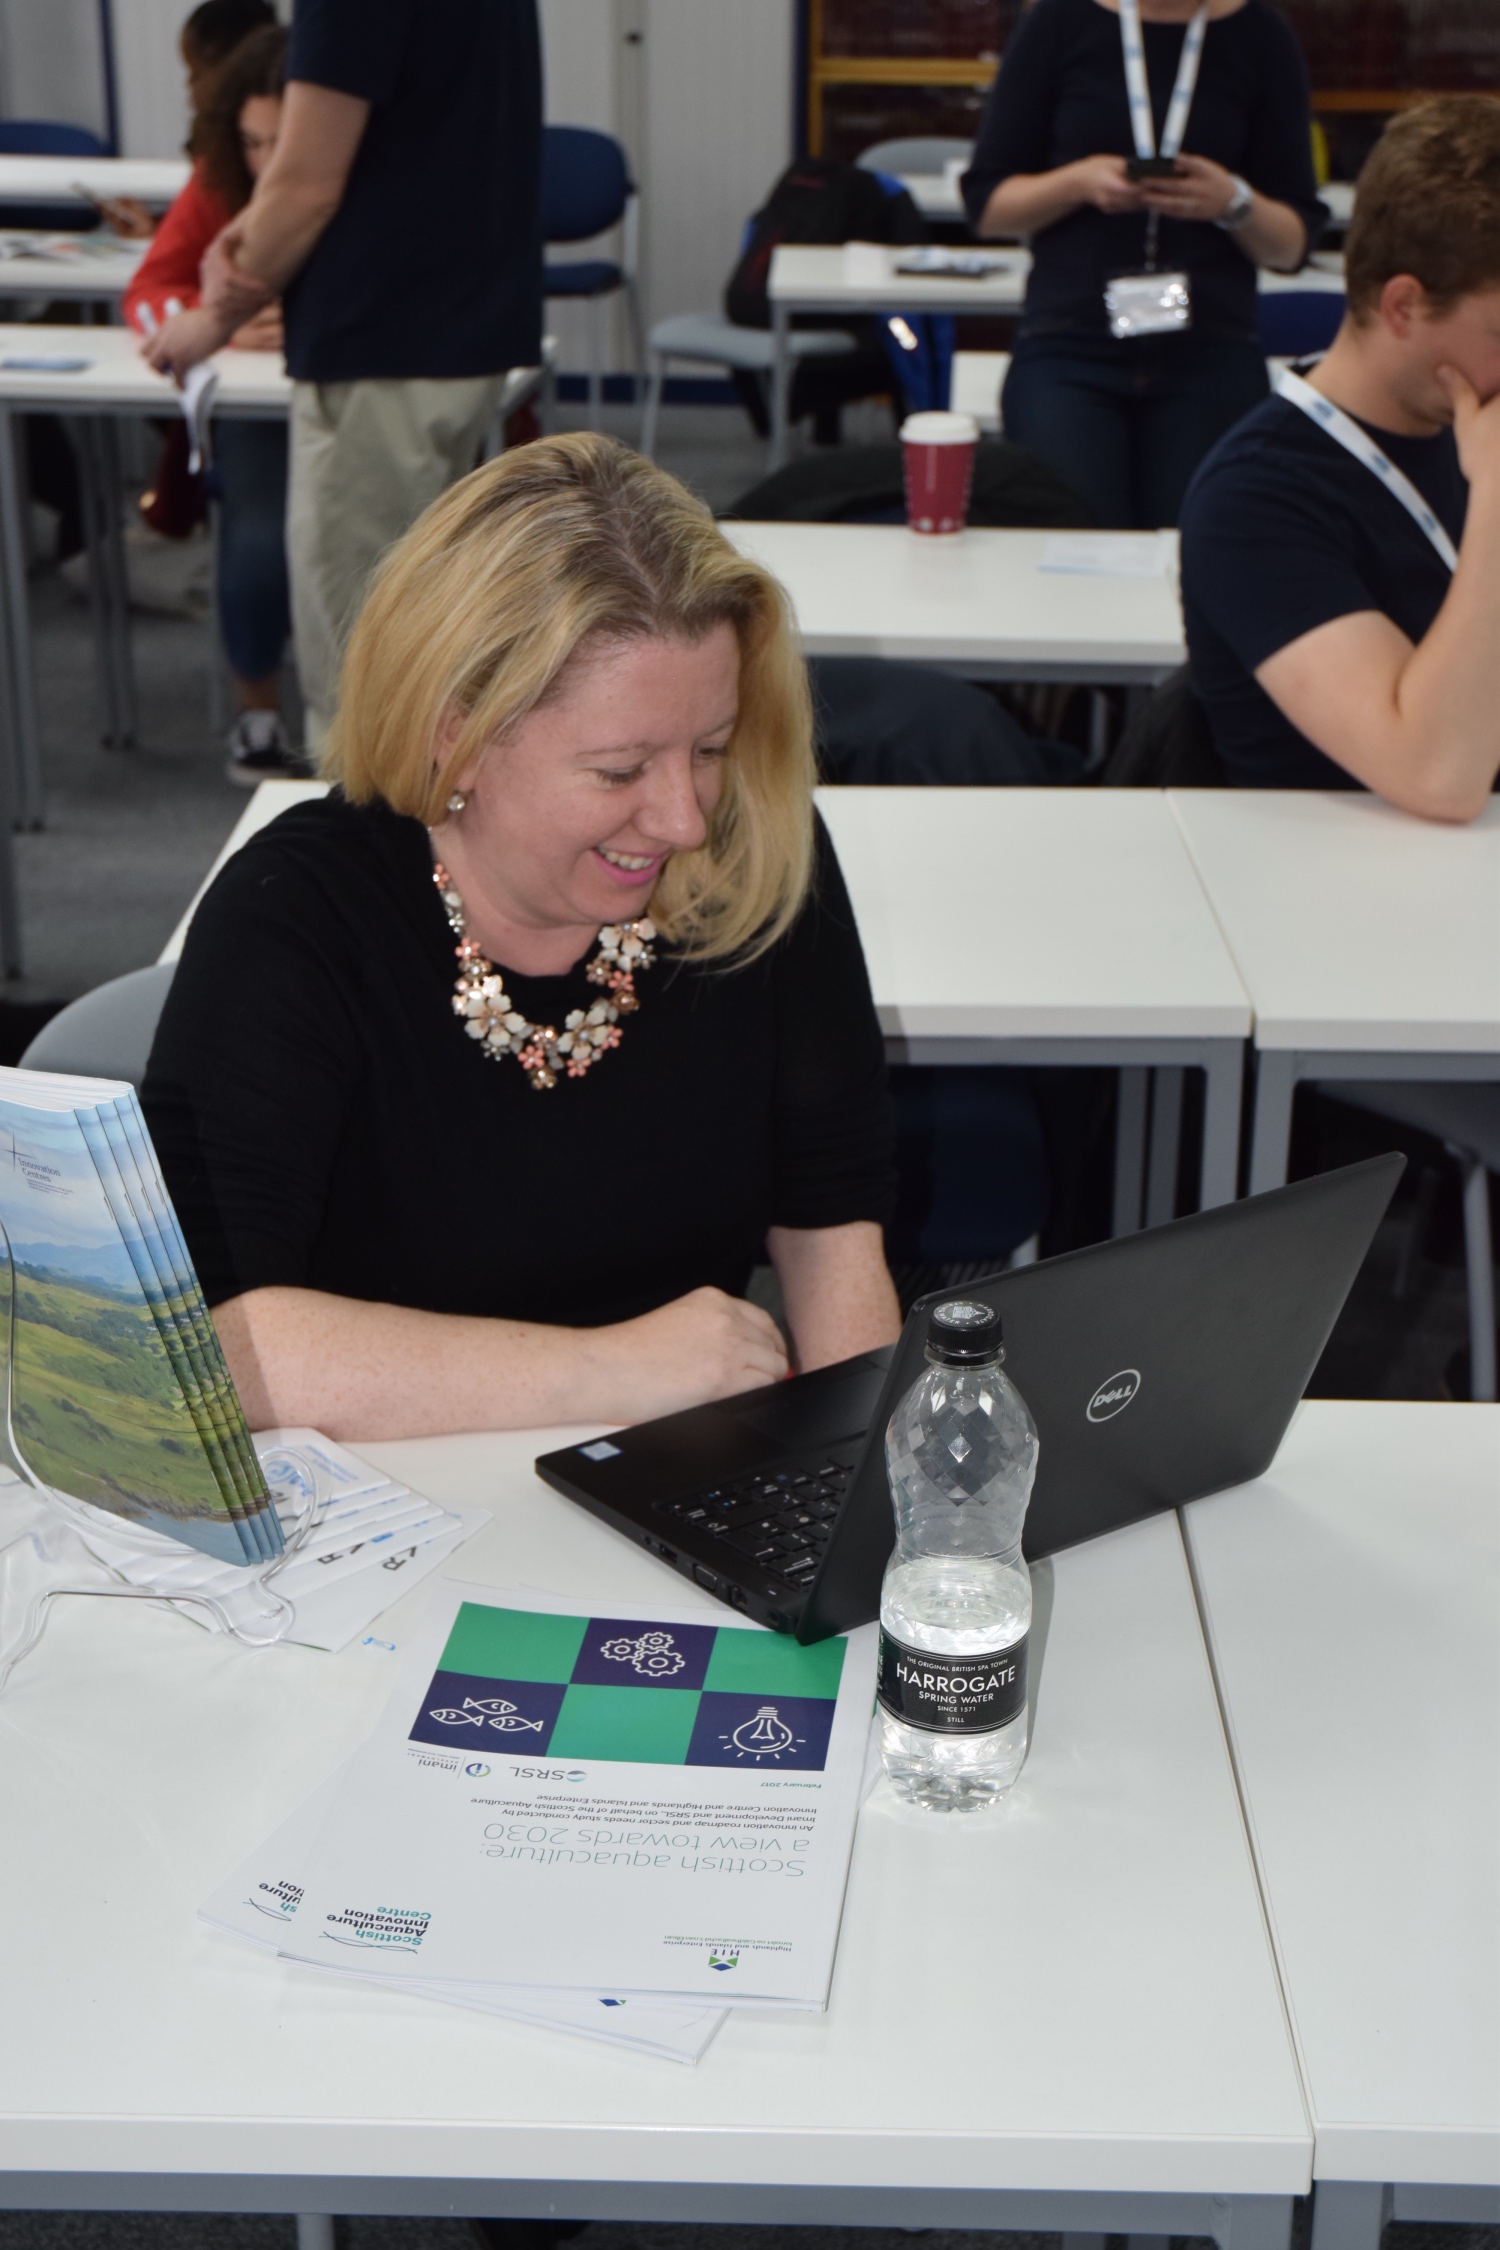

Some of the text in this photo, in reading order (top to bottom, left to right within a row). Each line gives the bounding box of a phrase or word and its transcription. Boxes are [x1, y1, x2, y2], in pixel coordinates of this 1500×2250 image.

[18, 1158, 61, 1176] Innovation
[22, 1168, 52, 1182] Centres
[1092, 1384, 1132, 1408] DELL
[906, 1656, 916, 1665] THE
[918, 1660, 950, 1672] ORIGINAL
[990, 1658, 1008, 1668] TOWN
[896, 1662, 1016, 1693] HARROGATE
[918, 1690, 994, 1704] SPRING WATER
[418, 1759, 457, 1772] imani
[509, 1766, 566, 1781] SRSL
[470, 1798, 532, 1809] Aquaculture
[536, 1794, 589, 1804] Enterprise
[516, 1811, 570, 1819] conducted
[534, 1803, 576, 1812] Scottish
[714, 1813, 784, 1822] Development
[483, 1823, 810, 1853] a view towards 2030
[480, 1843, 806, 1877] Scottish aquaculture:
[344, 1908, 429, 1929] Innovation
[376, 1906, 432, 1920] Centre
[326, 1914, 426, 1938] Aquaculture
[355, 1929, 423, 1946] Scottish
